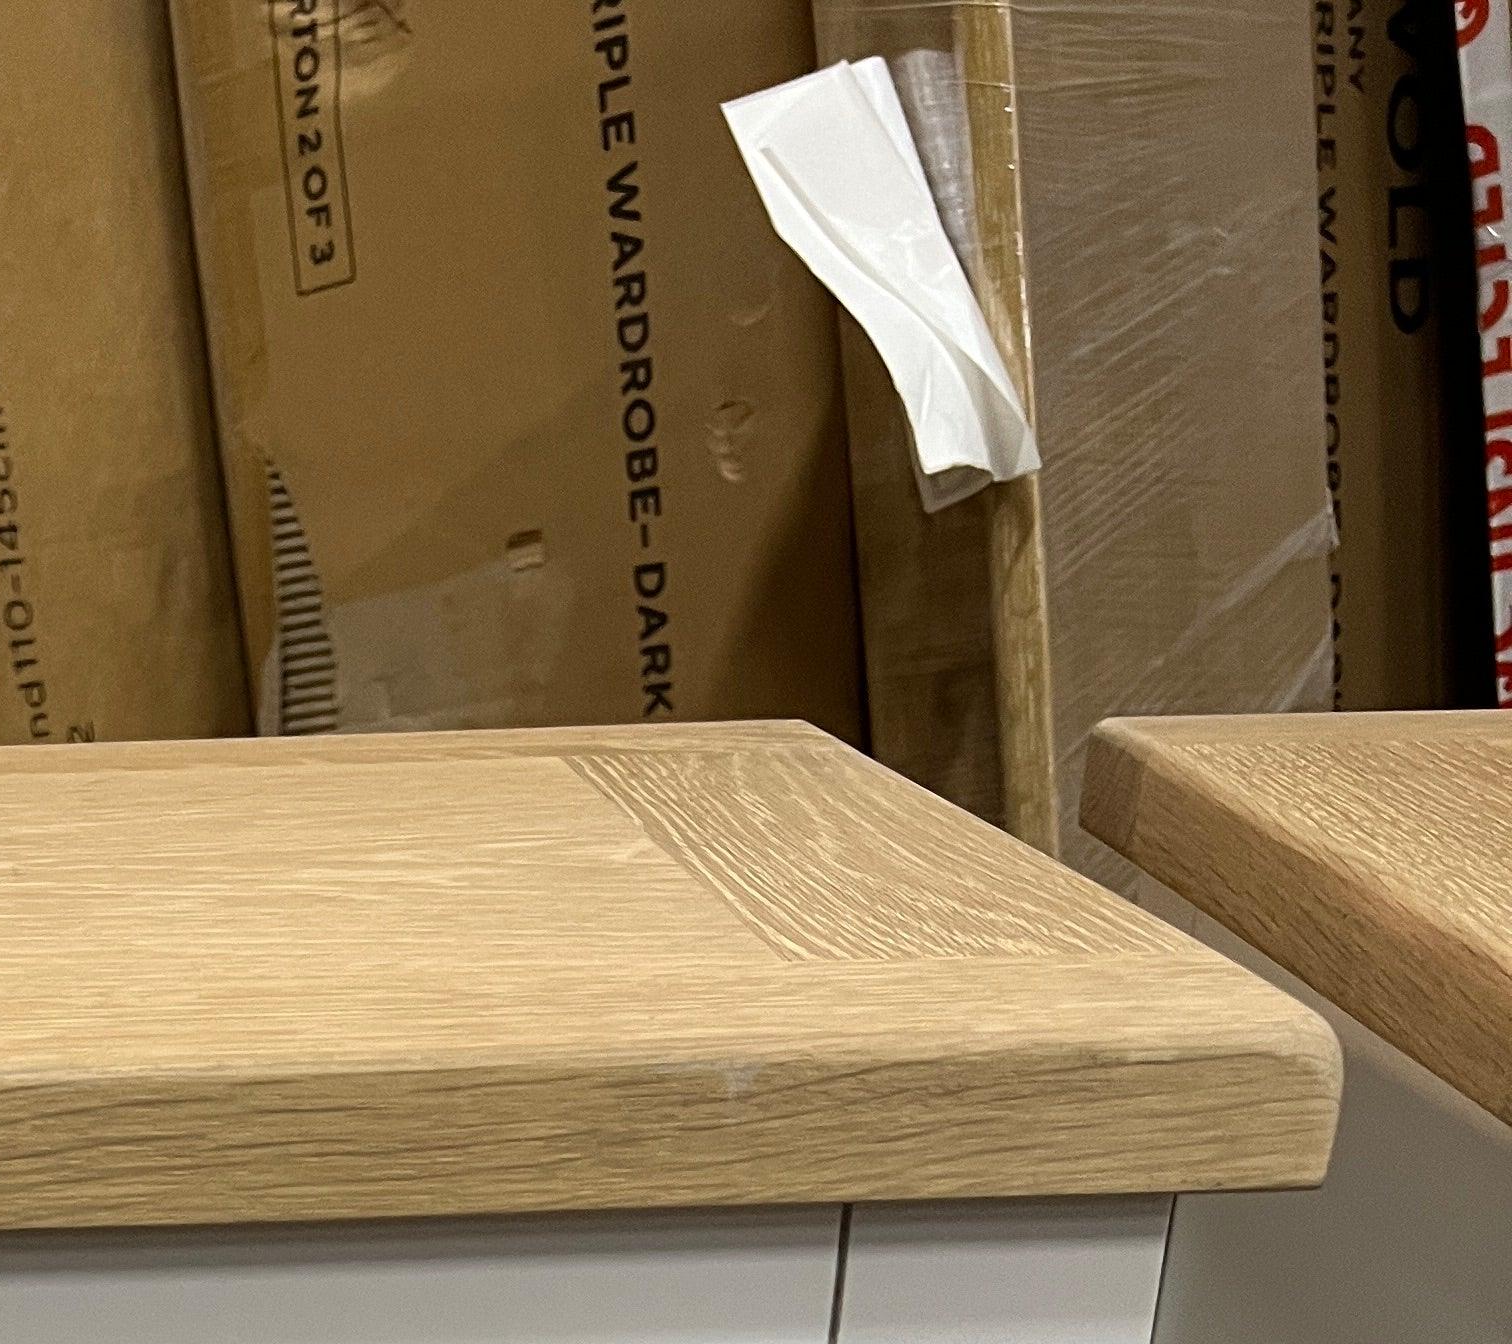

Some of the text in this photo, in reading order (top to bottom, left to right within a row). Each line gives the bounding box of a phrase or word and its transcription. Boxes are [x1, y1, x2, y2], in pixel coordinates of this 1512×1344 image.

[297, 129, 323, 157] 2
[302, 165, 332, 229] OF
[309, 239, 336, 266] 3
